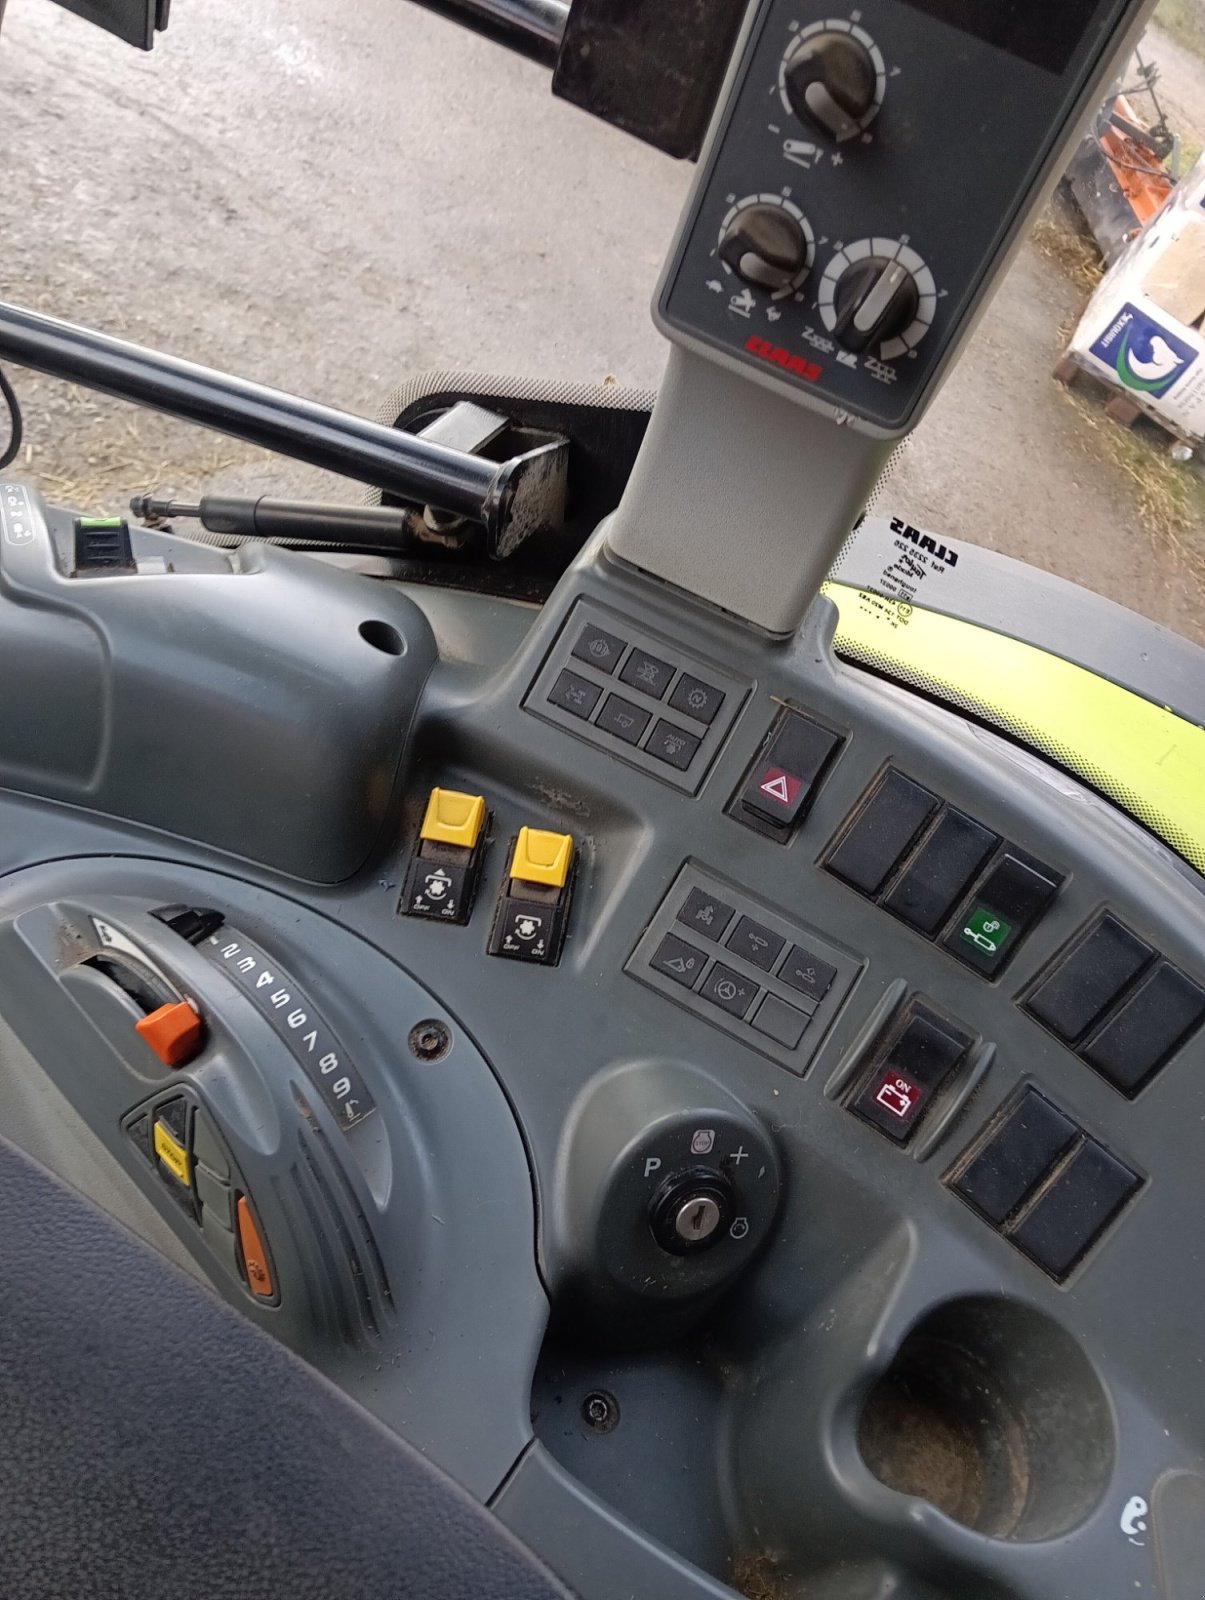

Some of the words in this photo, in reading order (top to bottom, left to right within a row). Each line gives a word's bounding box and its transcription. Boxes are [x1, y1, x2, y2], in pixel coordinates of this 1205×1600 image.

[745, 335, 823, 382] CLAAS
[413, 903, 430, 911] OFF
[441, 908, 455, 916] ON
[503, 943, 520, 951] OFF
[531, 948, 545, 956] ON
[220, 943, 242, 959] 2
[236, 956, 257, 973] 3
[256, 970, 275, 988] 4
[270, 988, 291, 1009] 5
[287, 1008, 307, 1029] 6
[302, 1030, 318, 1052] 7
[319, 1052, 339, 1074] 8
[333, 1076, 351, 1100] 9
[895, 1078, 912, 1094] ON
[643, 1157, 662, 1177] P
